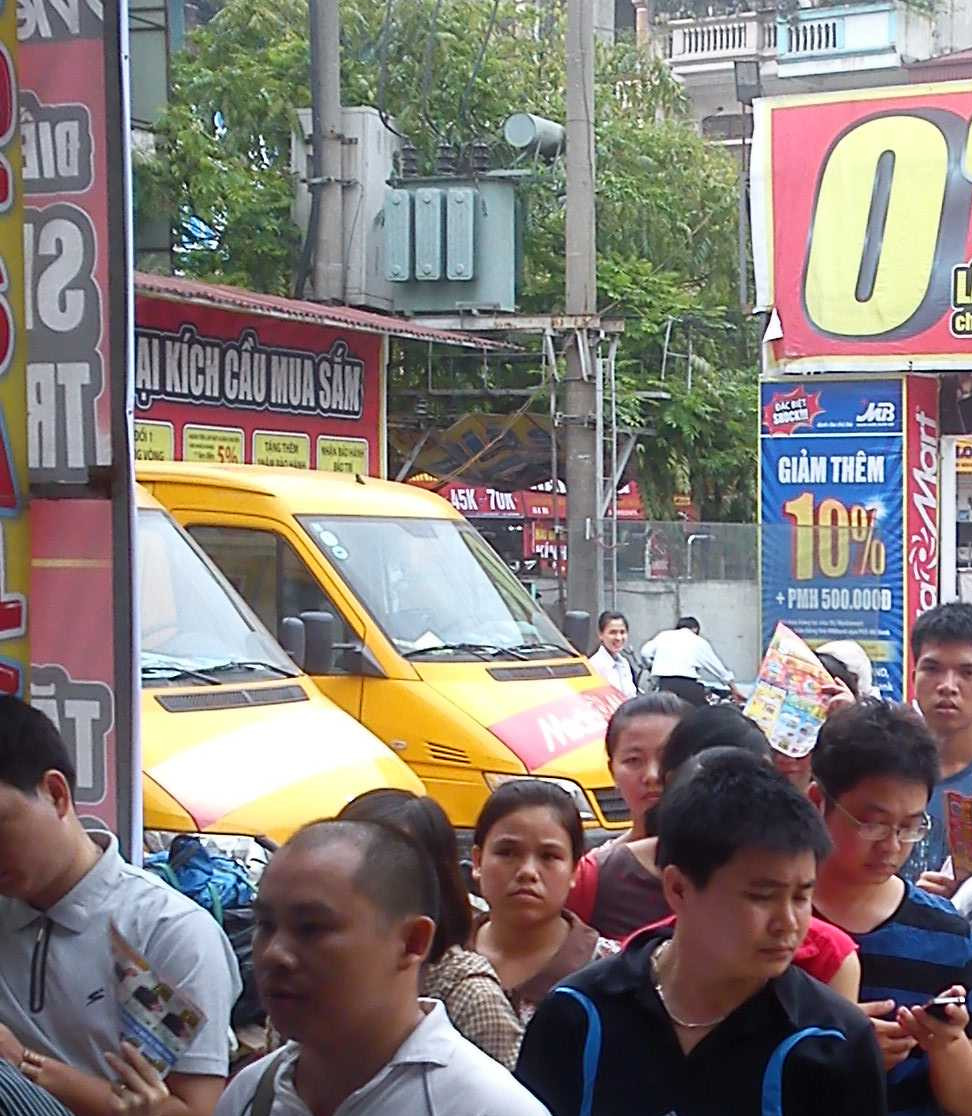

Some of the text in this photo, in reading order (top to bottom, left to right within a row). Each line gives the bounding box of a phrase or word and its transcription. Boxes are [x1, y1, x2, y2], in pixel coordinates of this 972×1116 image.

[165, 332, 220, 397] KÍCH
[224, 336, 267, 402] CẦU
[271, 355, 315, 407] MUA
[319, 347, 362, 412] SẮM
[778, 448, 885, 484] GIẢM THÊM
[784, 492, 886, 580] 10%
[788, 588, 819, 610] PMH
